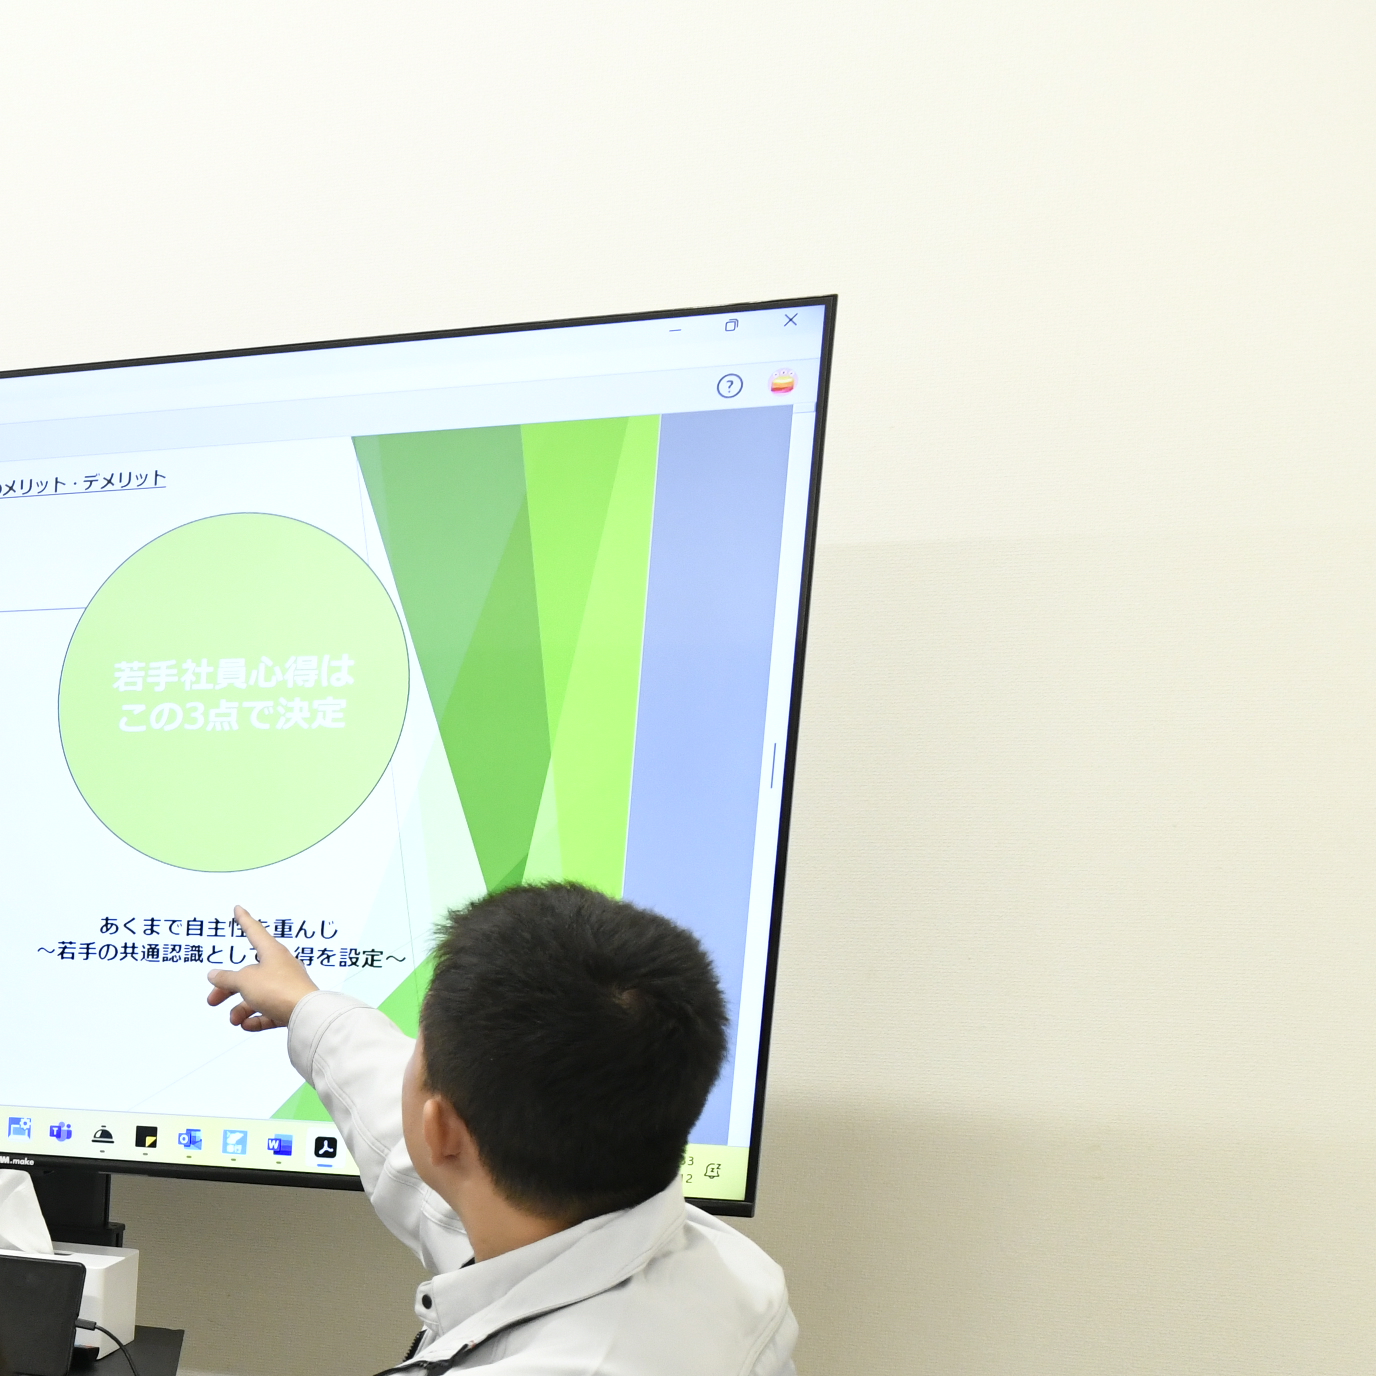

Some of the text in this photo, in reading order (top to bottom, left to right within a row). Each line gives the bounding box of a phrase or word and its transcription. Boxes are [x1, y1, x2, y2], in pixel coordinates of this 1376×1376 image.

[112, 653, 355, 692] 若手社員心得は
[118, 695, 348, 733] この3点で決定
